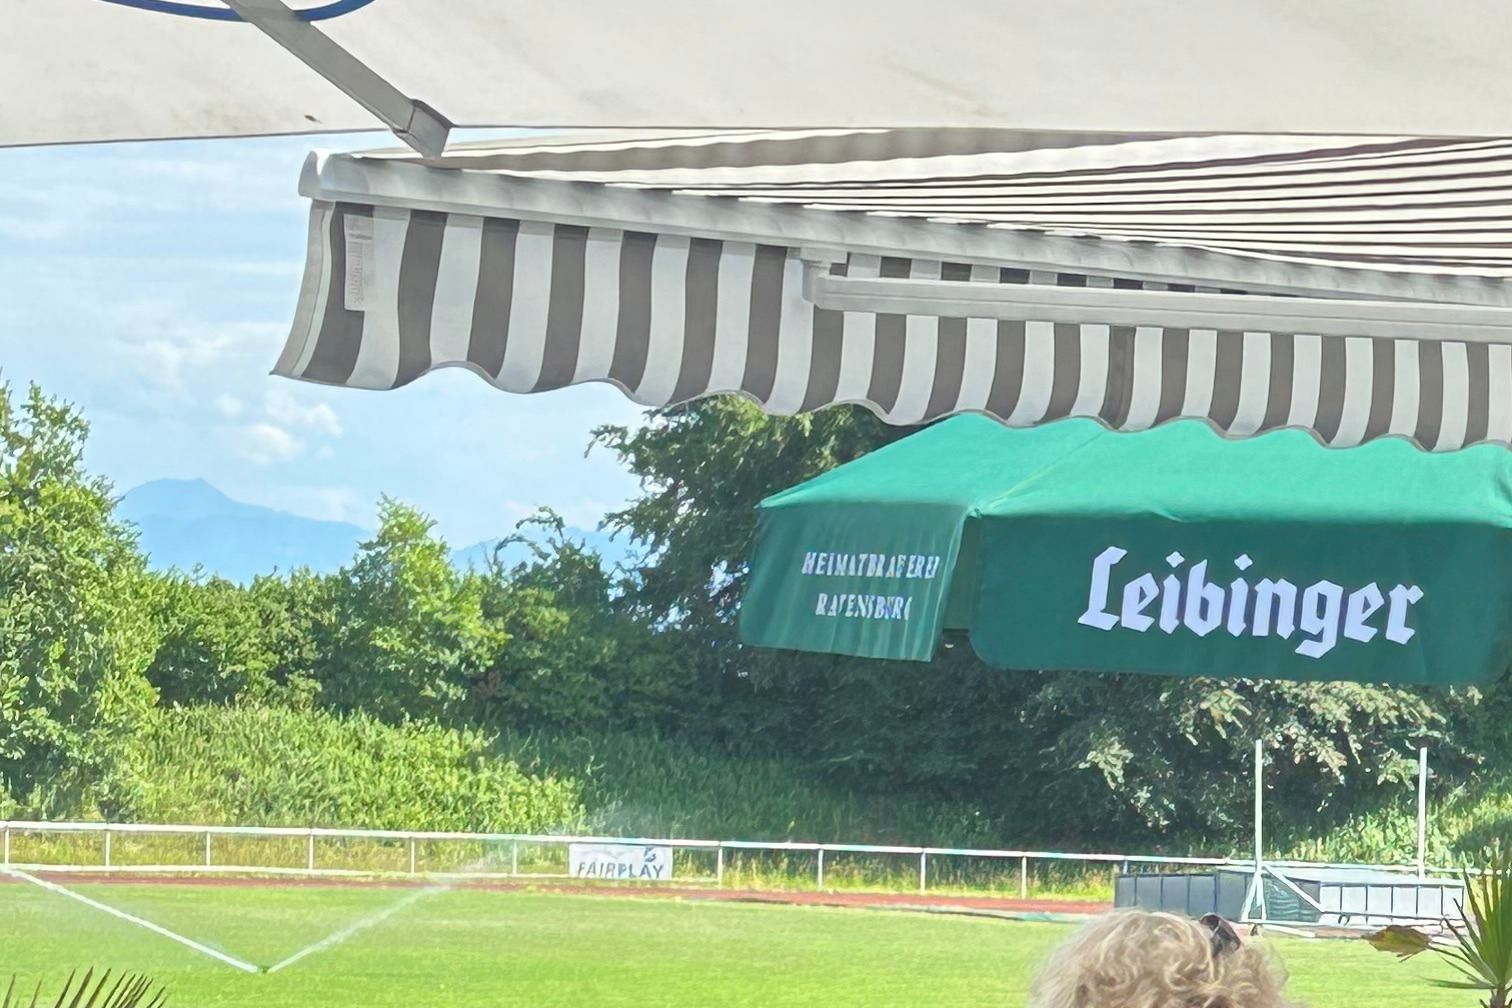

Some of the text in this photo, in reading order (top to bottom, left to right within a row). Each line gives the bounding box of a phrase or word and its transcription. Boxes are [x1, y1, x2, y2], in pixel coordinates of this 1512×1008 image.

[801, 552, 940, 579] HEIMATBRAEREI
[1078, 545, 1424, 658] Leibinger
[578, 861, 663, 878] FAIRPLAY
